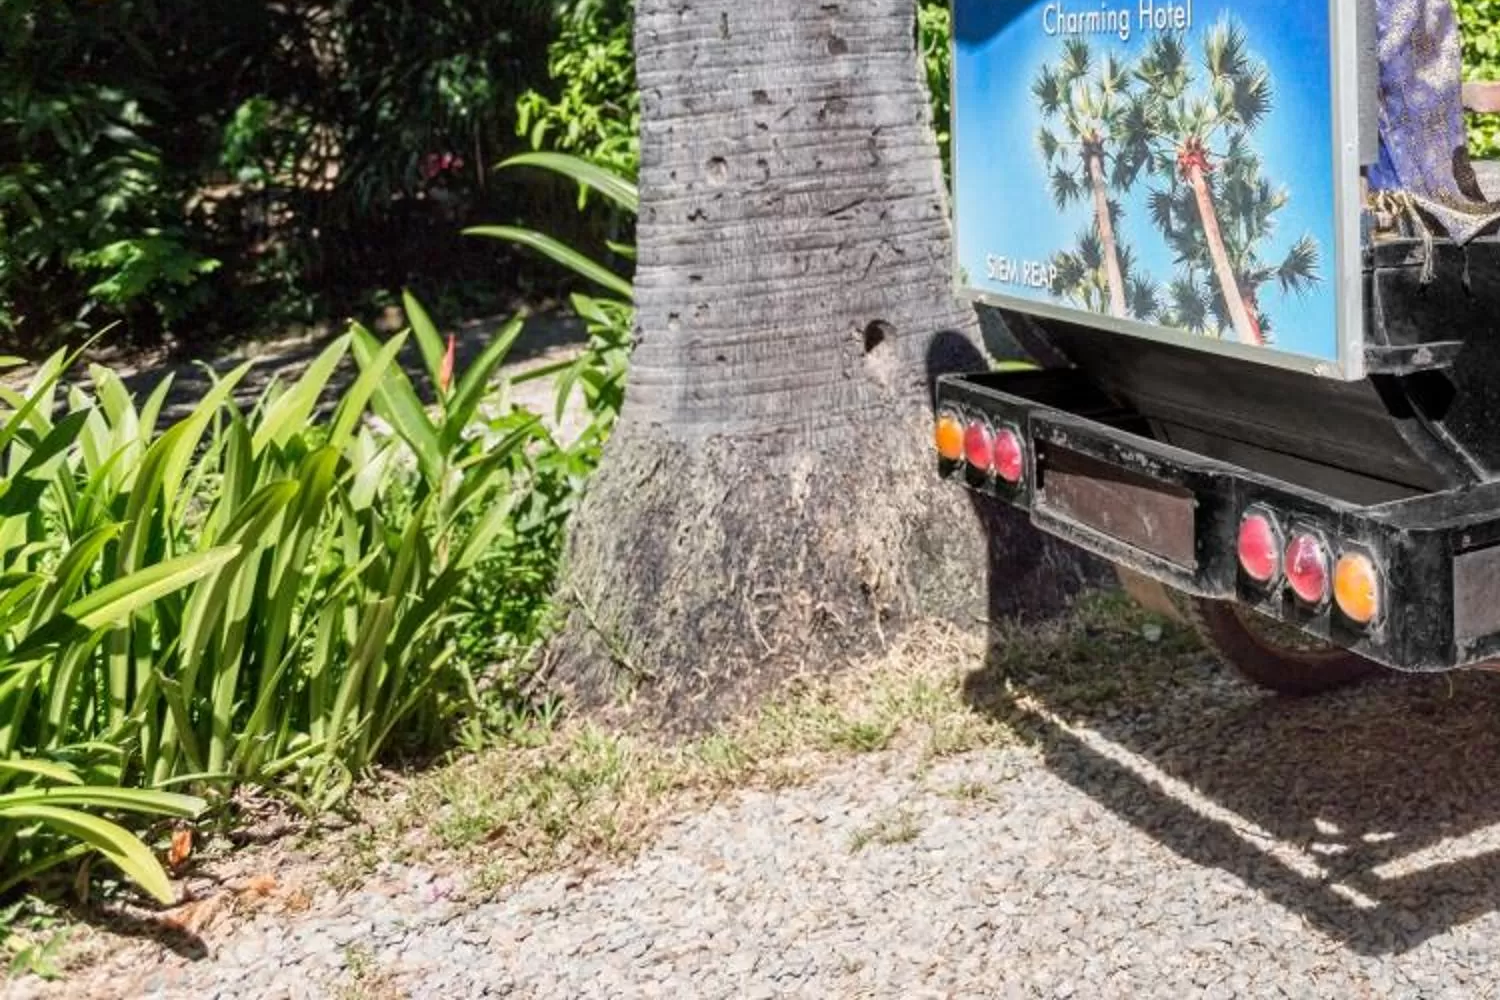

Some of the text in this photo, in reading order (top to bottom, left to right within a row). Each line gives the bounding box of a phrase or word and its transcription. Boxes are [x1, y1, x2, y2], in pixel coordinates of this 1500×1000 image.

[1042, 2, 1130, 41] Charming
[986, 253, 1057, 289] SIEM REAP
